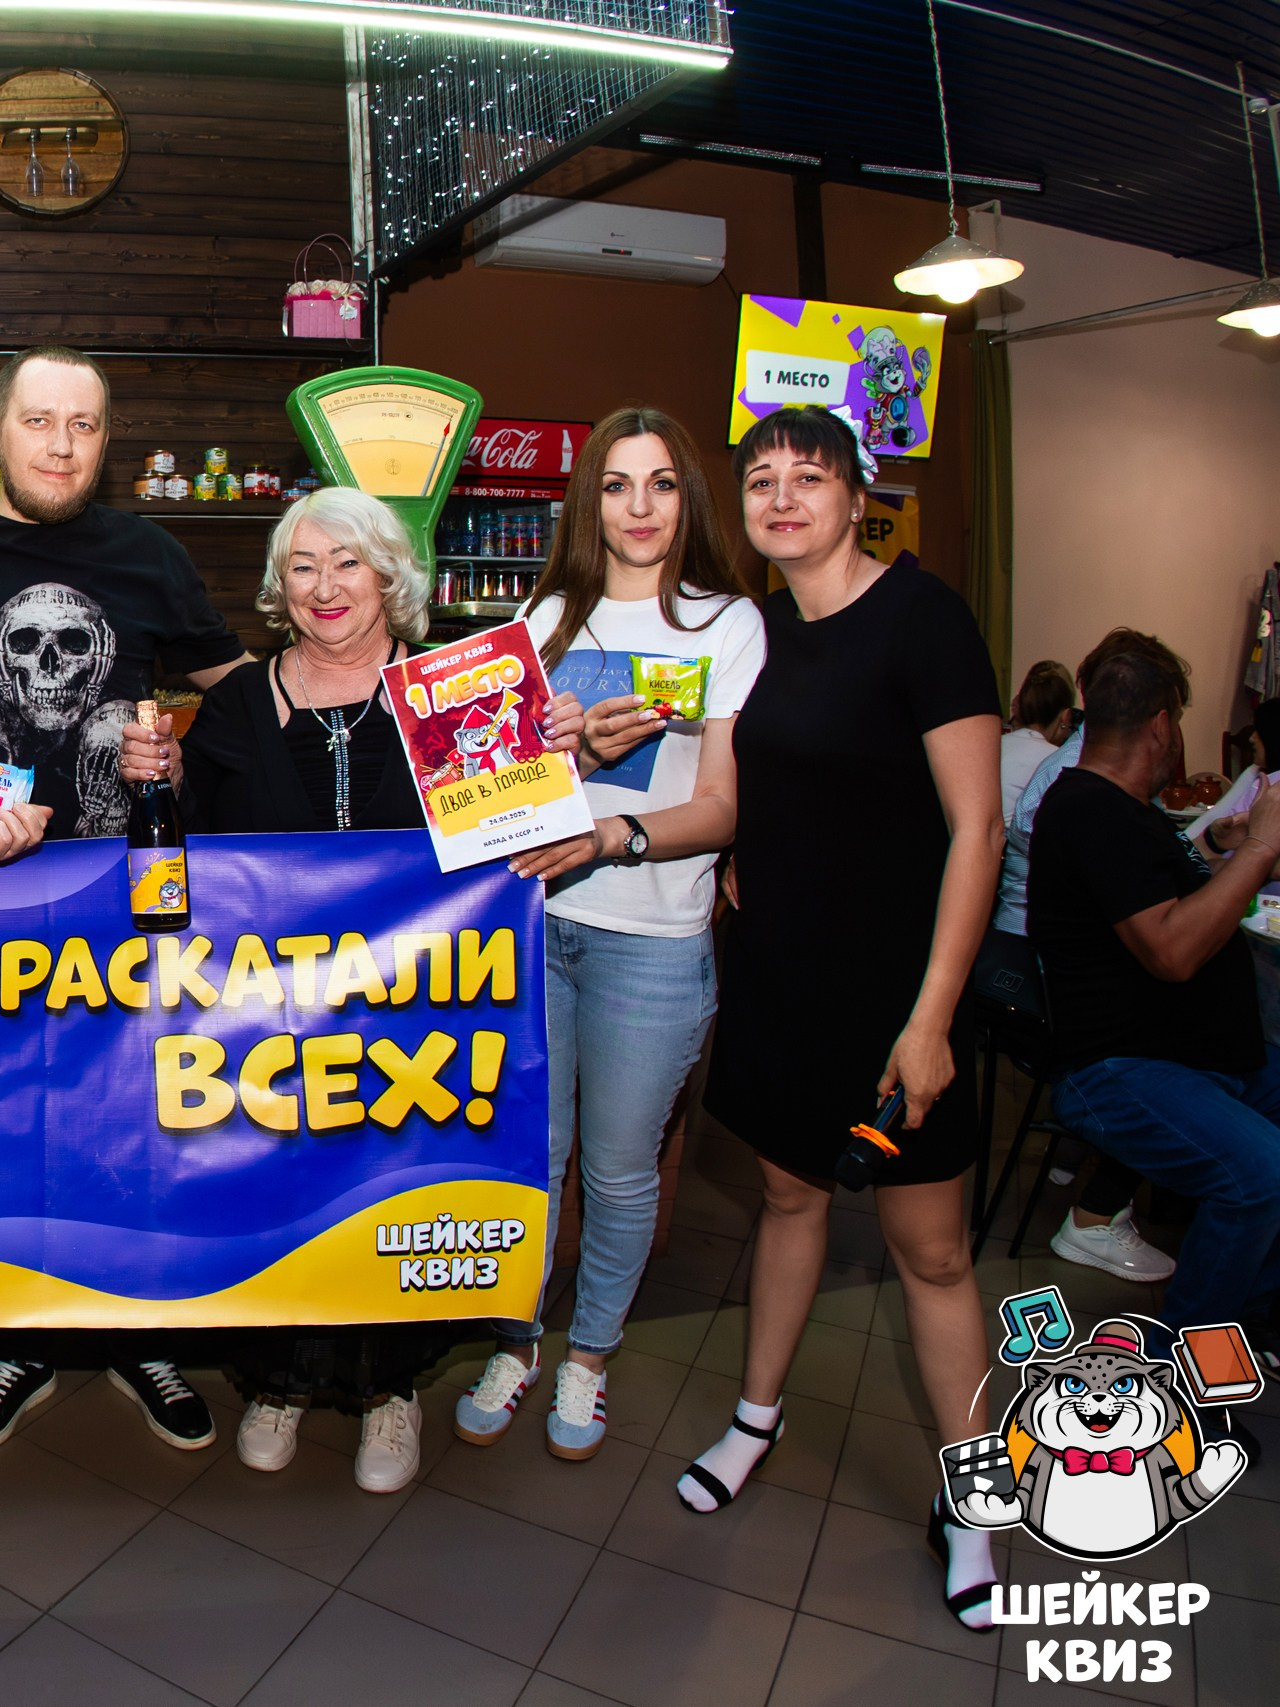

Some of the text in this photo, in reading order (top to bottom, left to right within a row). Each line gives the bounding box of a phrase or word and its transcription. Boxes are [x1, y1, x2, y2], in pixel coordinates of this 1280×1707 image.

[764, 370, 830, 388] 1 МЕСТО
[465, 428, 543, 469] a-Cola
[464, 487, 525, 497] 8-800-700-7777
[420, 642, 494, 675] ШЕЙКЕР КВИЗ
[405, 655, 525, 719] 1 МЕСТО
[648, 680, 681, 690] КИСЕЛЬ
[483, 836, 508, 848] НАЗАД
[515, 828, 532, 839] СССР
[153, 1030, 509, 1137] ВСЕХ!
[376, 1213, 526, 1256] ШЕЙКЕР
[399, 1257, 500, 1292] КВИЗ
